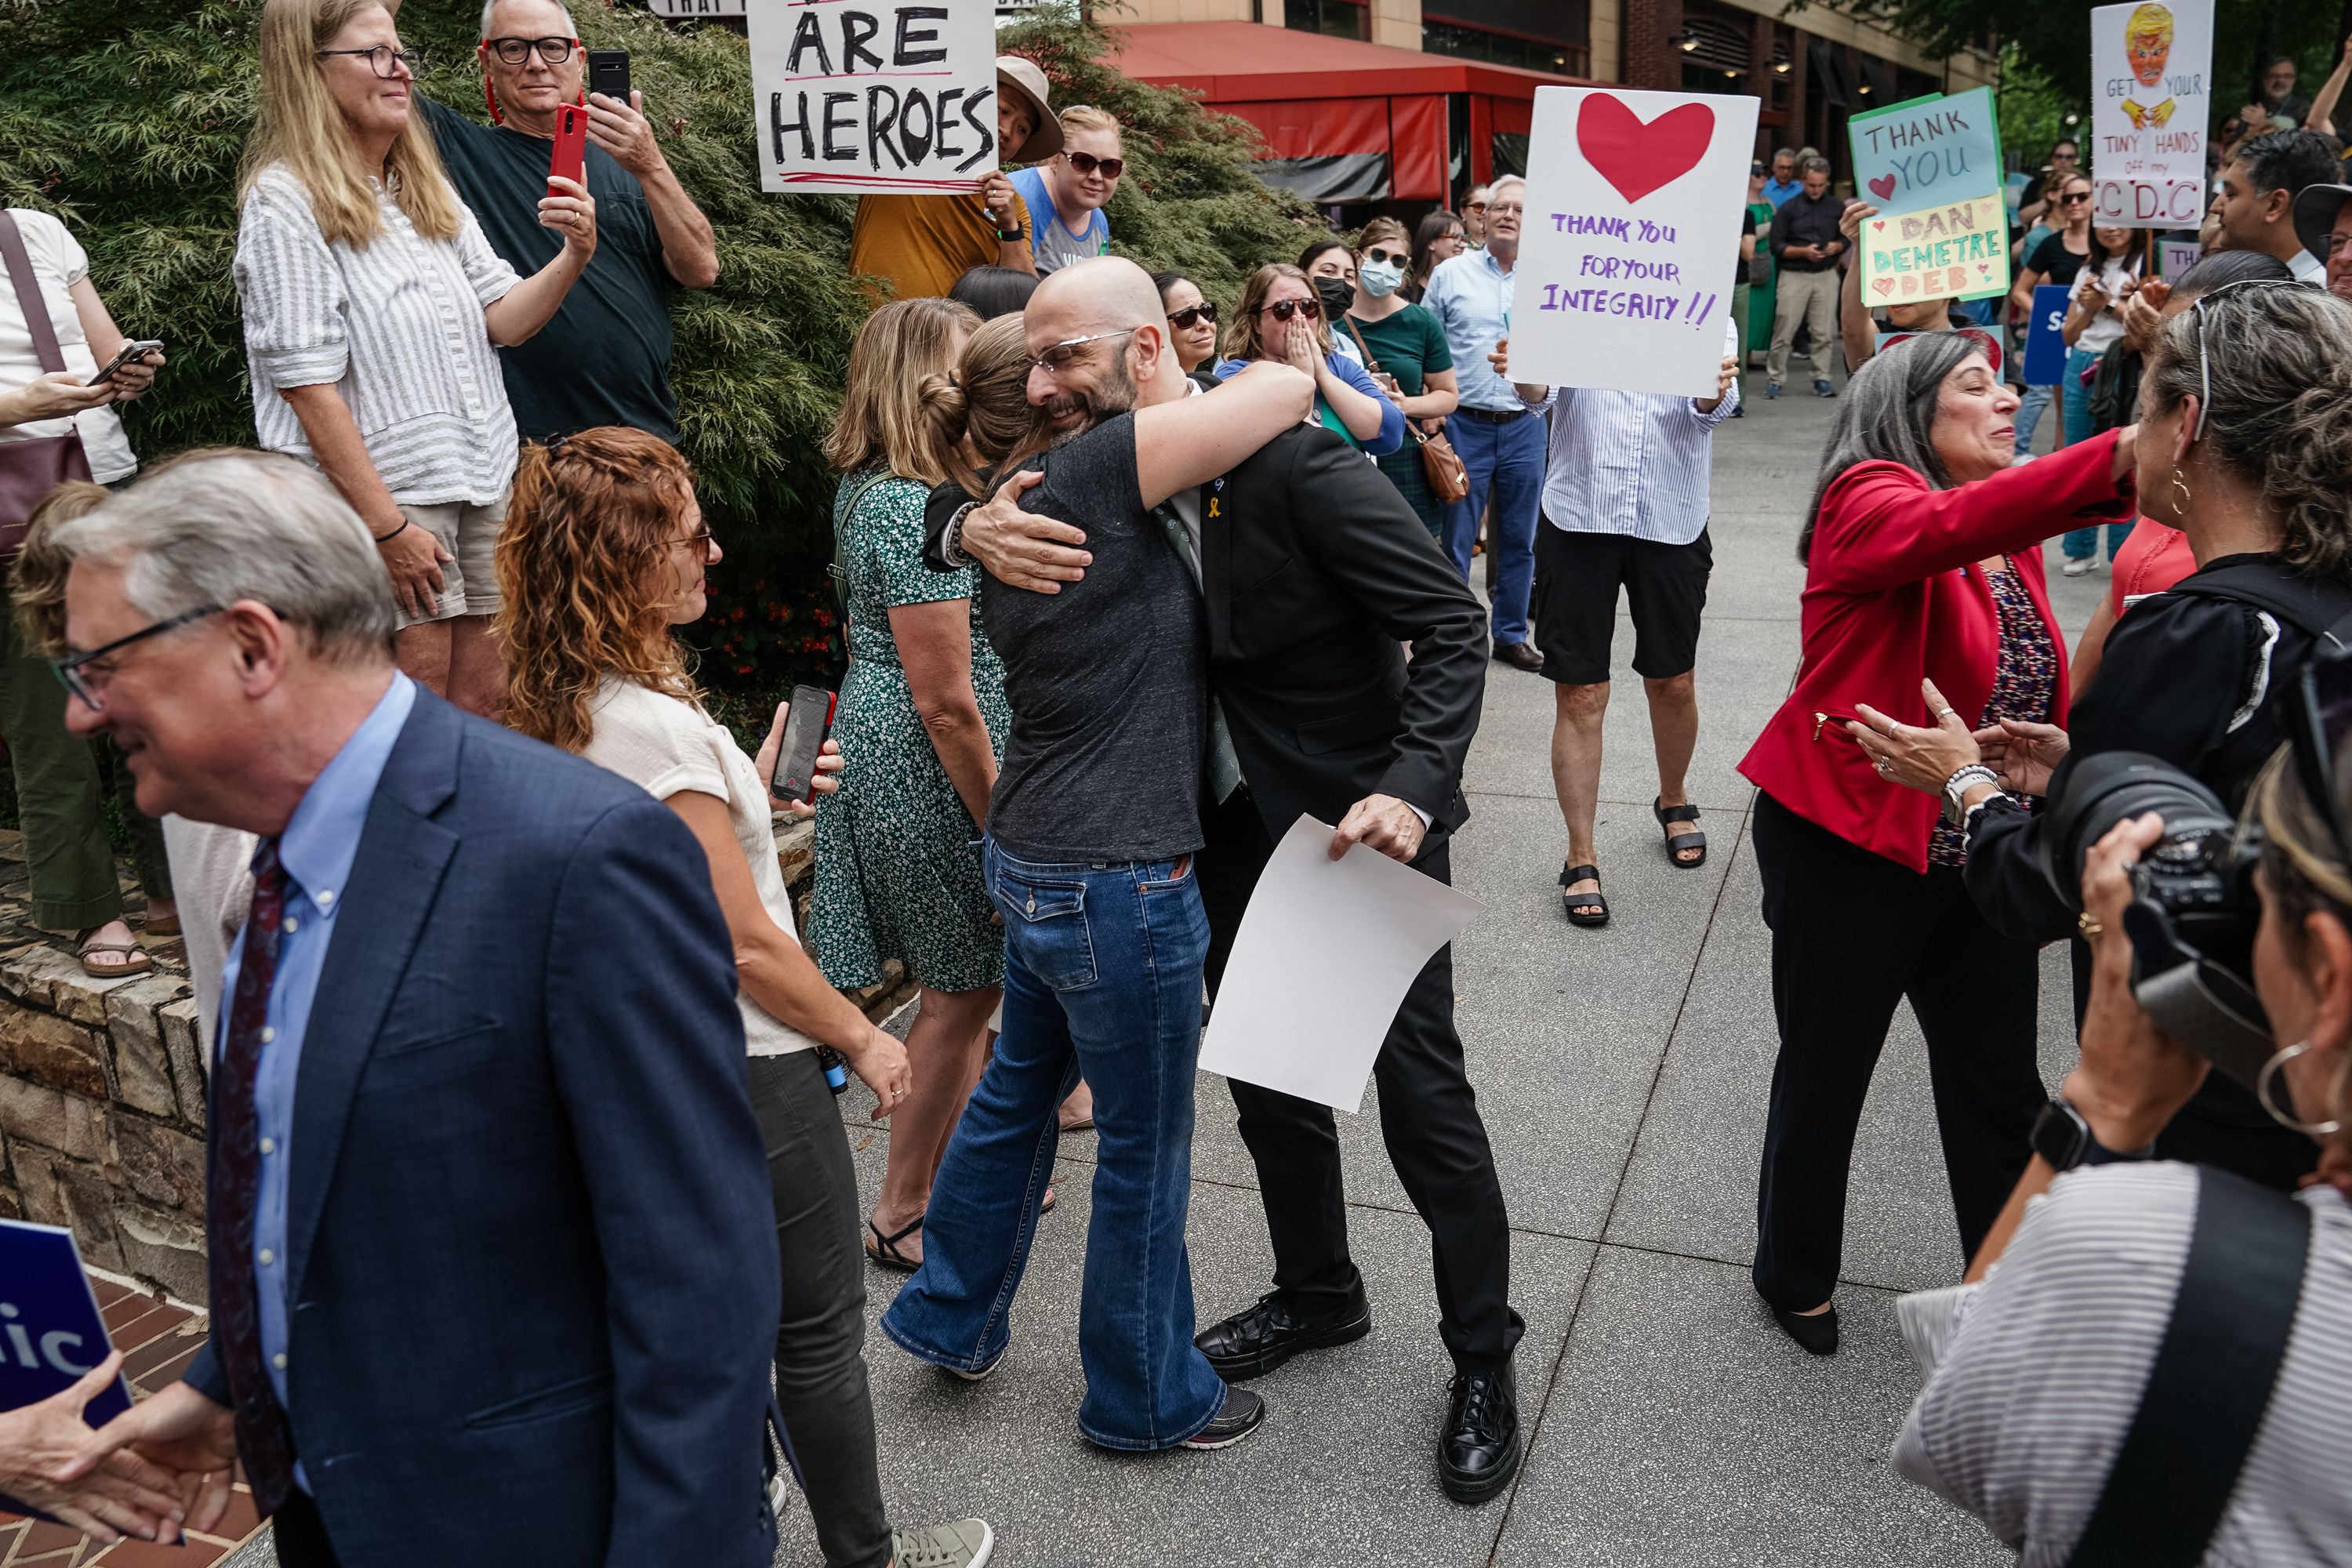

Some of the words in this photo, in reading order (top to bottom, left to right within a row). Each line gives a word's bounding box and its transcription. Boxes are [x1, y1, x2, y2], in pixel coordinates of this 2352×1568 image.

[786, 7, 948, 76] ARE
[2107, 78, 2135, 96] GET
[2164, 74, 2202, 96] YOUR
[771, 85, 994, 174] HEROES
[1864, 111, 1969, 154] THANK
[2103, 134, 2140, 154] TINY
[2155, 131, 2200, 155] HANDS
[1890, 147, 1971, 191] YOU
[2151, 162, 2169, 176] my
[1551, 213, 1630, 242] THANK
[1637, 220, 1676, 244] YOU
[1900, 203, 1975, 241] DAN
[1874, 230, 2002, 273] DEMETRE
[1900, 267, 1968, 296] DEB
